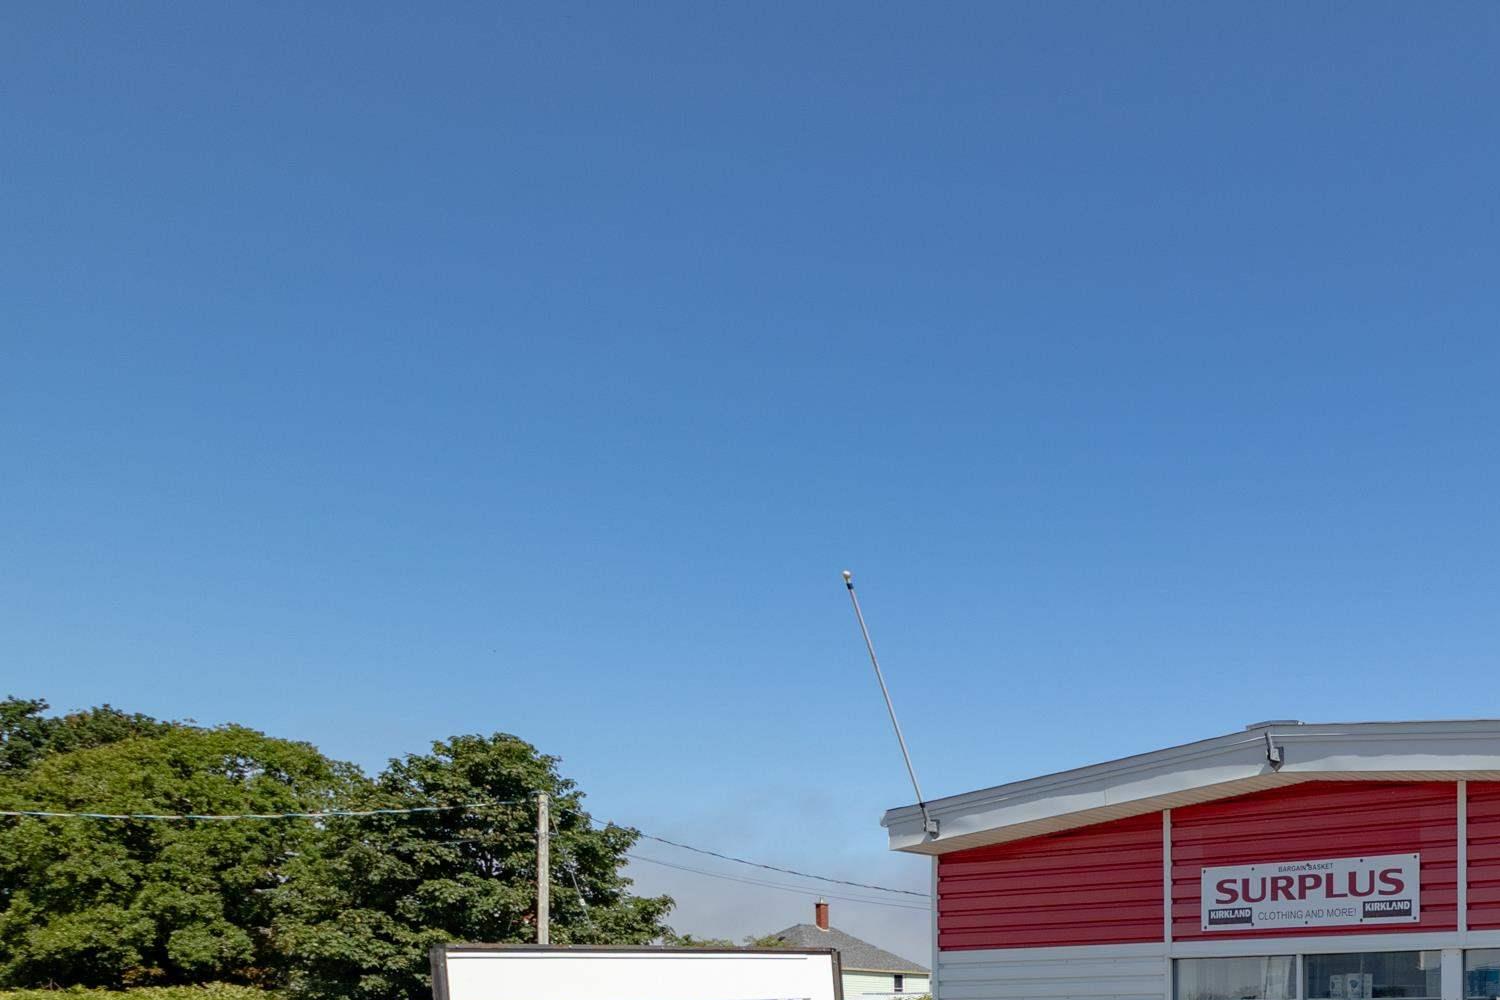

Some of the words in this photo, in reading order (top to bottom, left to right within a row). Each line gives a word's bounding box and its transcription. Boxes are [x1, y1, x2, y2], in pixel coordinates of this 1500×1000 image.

[1278, 864, 1307, 873] BARGAIN
[1308, 862, 1334, 871] BASKET
[1216, 868, 1405, 905] SURPLUS
[1364, 901, 1410, 911] KIRKLAND
[1210, 909, 1251, 919] KIRKLAND
[1257, 910, 1304, 921] CLOTHING
[1305, 908, 1324, 919] AND
[1326, 907, 1357, 918] MORE!
